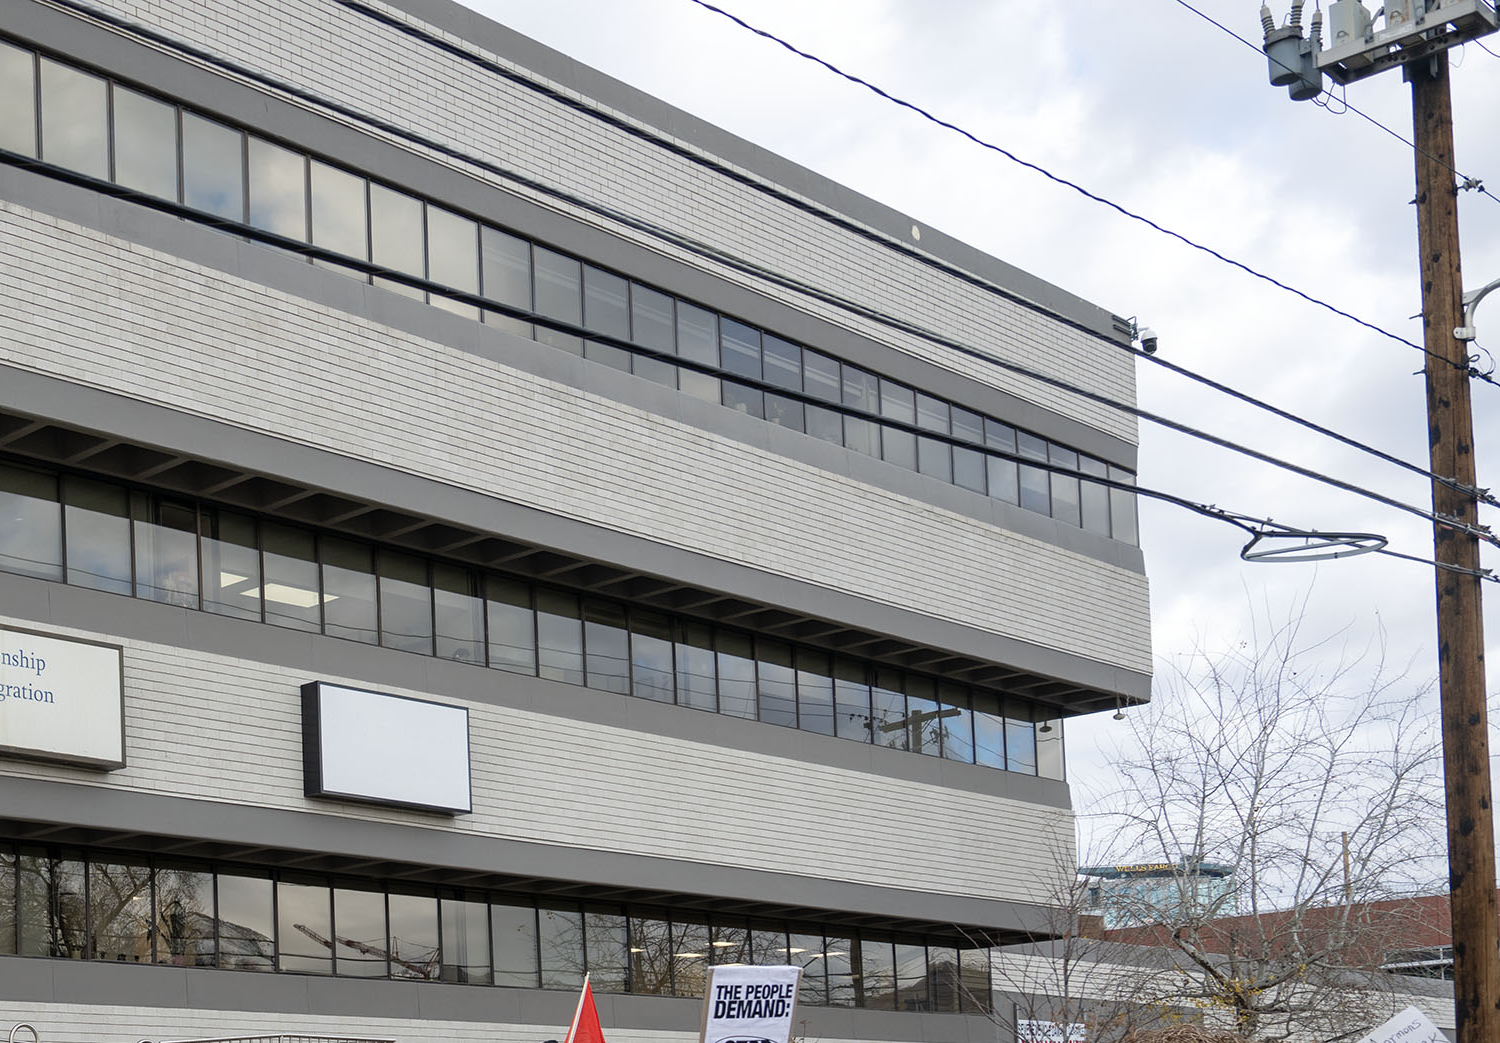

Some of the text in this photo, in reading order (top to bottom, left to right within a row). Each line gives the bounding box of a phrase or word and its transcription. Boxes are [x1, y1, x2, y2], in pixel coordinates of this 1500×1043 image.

[1115, 865, 1147, 873] WELLS
[716, 984, 794, 1000] THE PEOPLE
[713, 999, 791, 1019] DEMAND:
